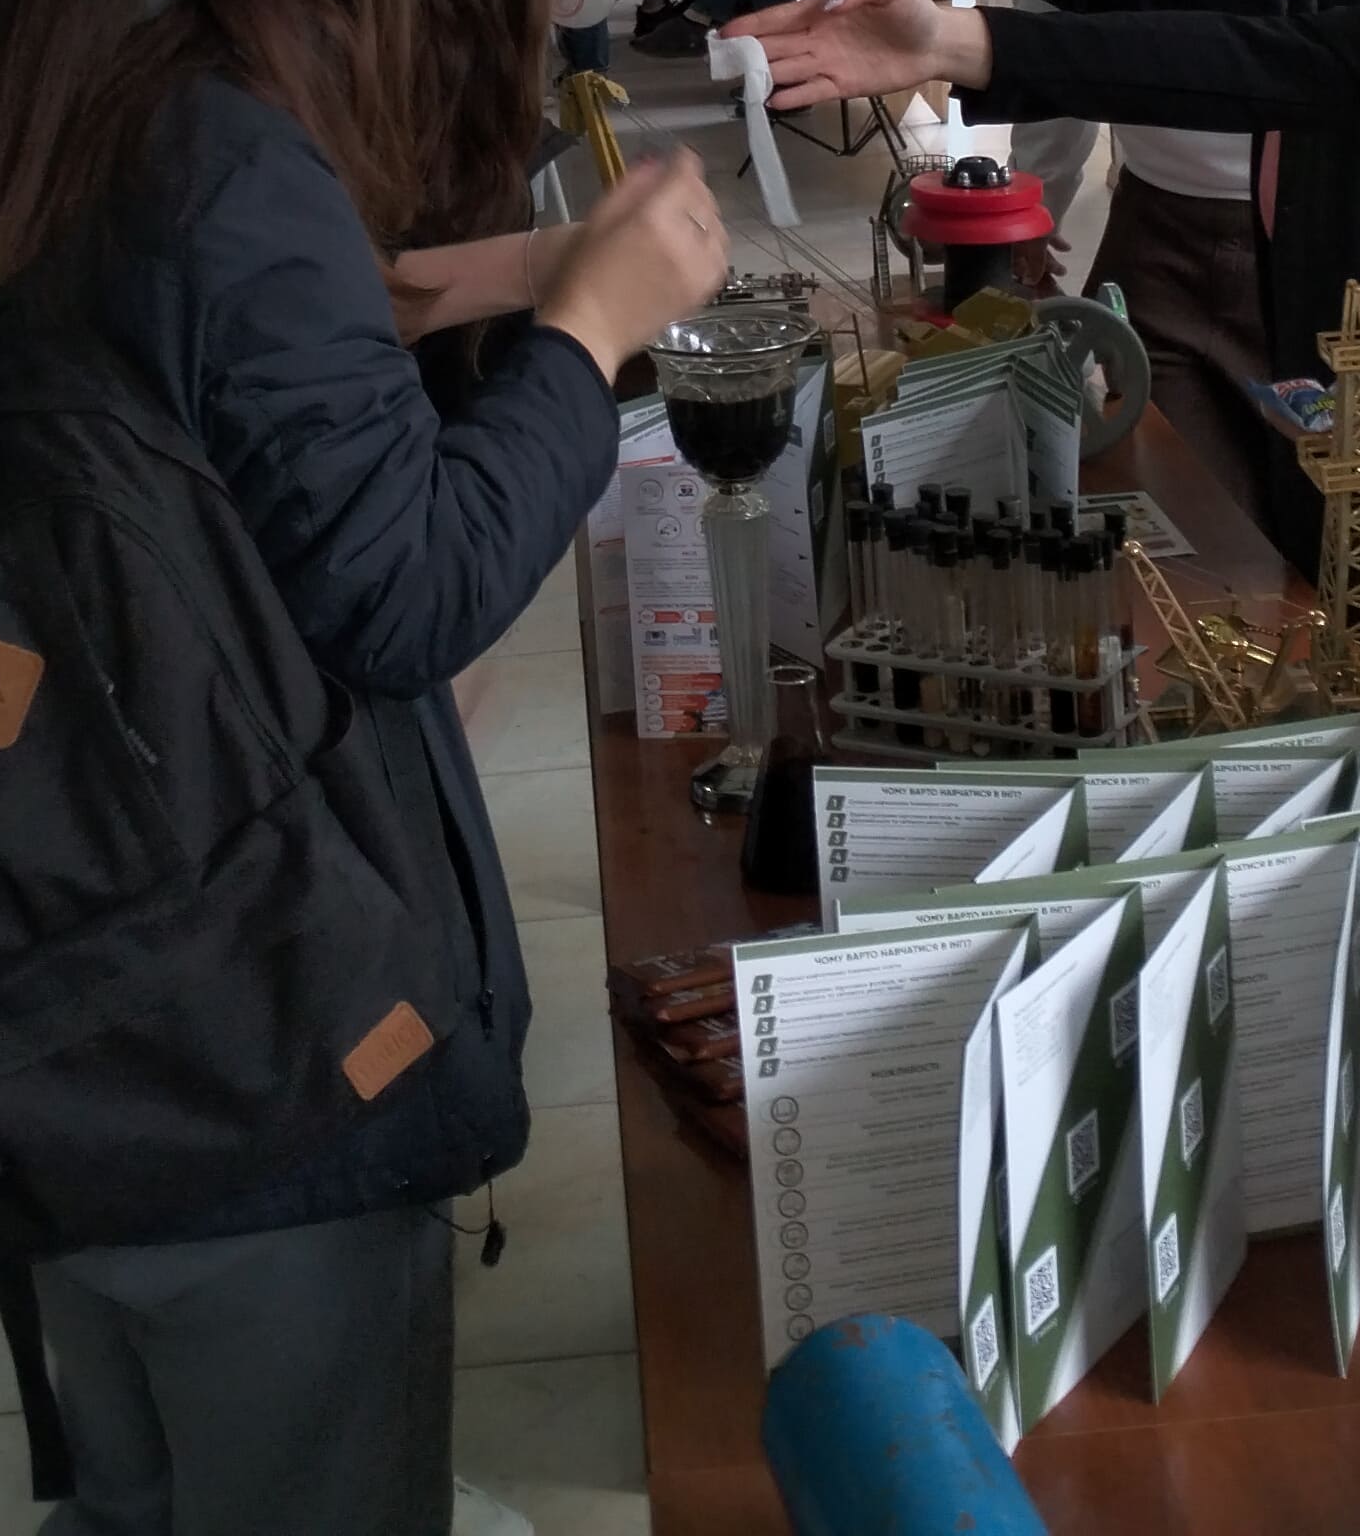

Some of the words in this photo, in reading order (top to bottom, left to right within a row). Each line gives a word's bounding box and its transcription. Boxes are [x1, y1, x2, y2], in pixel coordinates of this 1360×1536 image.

[814, 955, 844, 966] ЧОМУ
[846, 949, 879, 962] ВАРТО
[880, 943, 939, 957] НАВЧАТИСЯ
